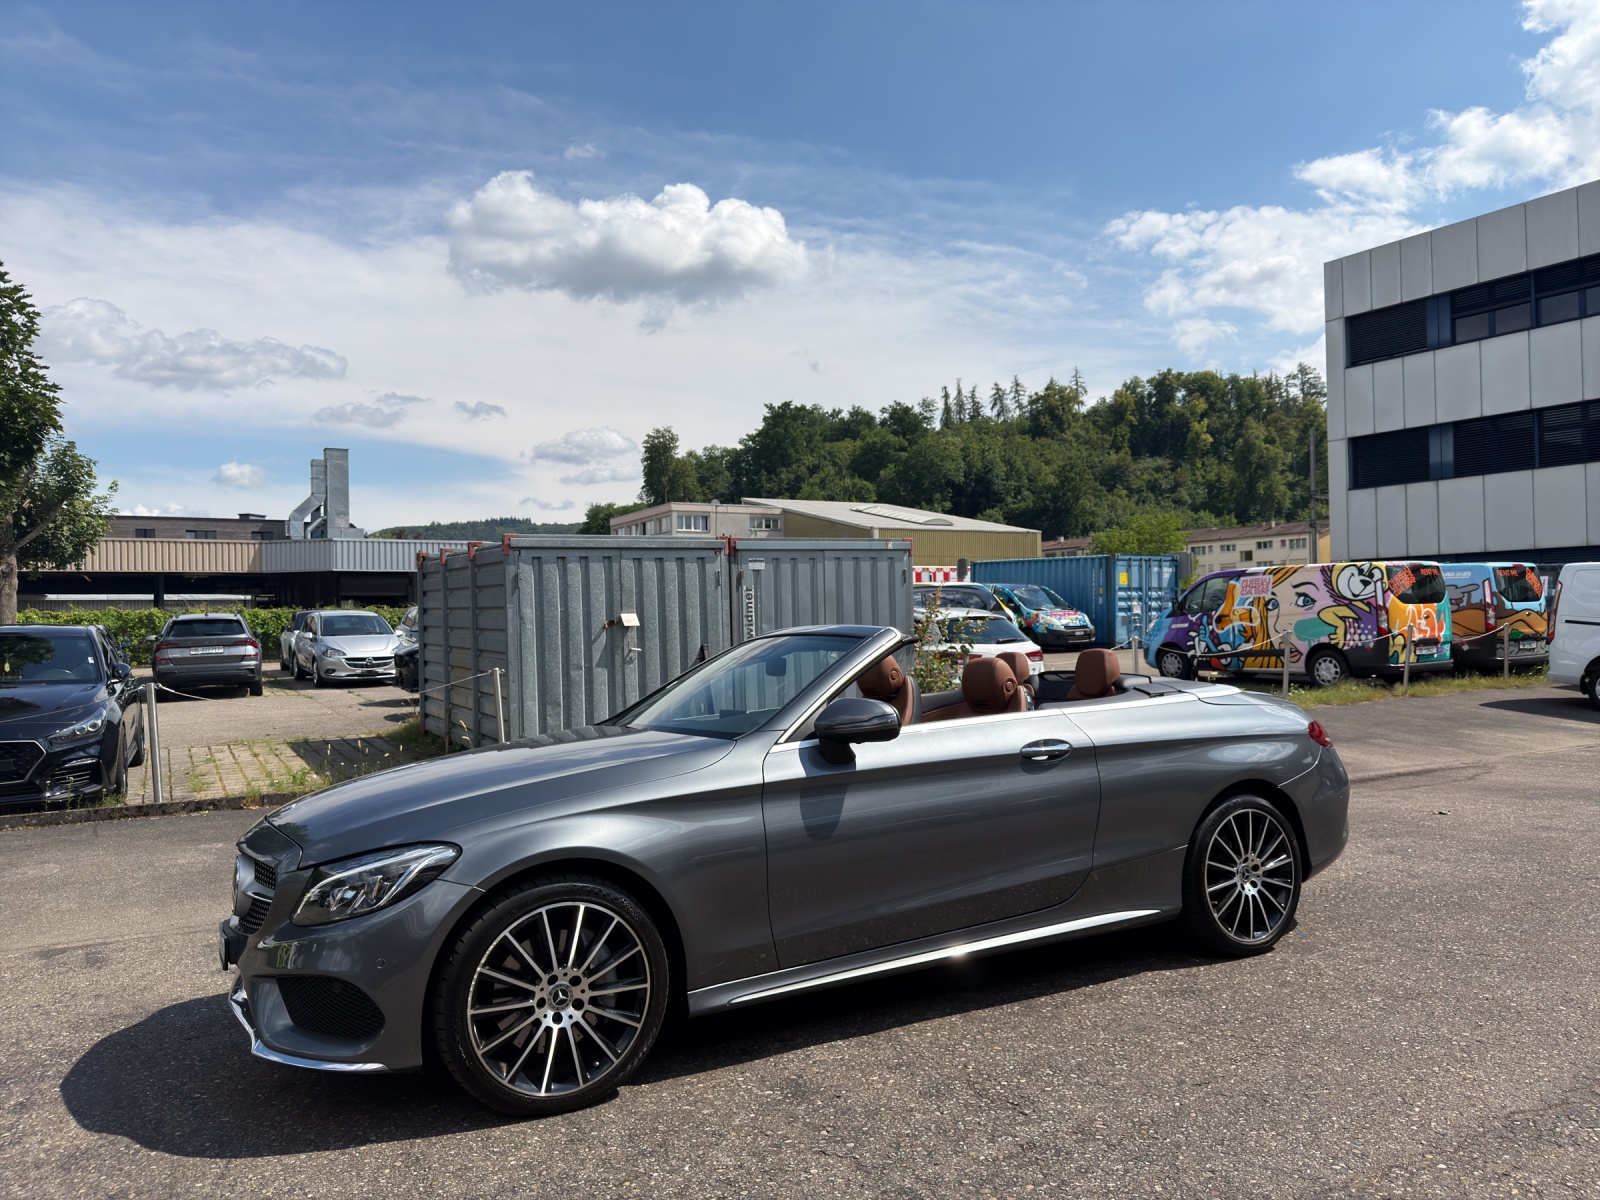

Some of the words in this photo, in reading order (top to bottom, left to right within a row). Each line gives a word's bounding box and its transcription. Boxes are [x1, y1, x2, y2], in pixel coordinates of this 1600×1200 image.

[1420, 568, 1431, 576] RENT
[1432, 568, 1440, 576] ME
[745, 586, 754, 639] widmer
